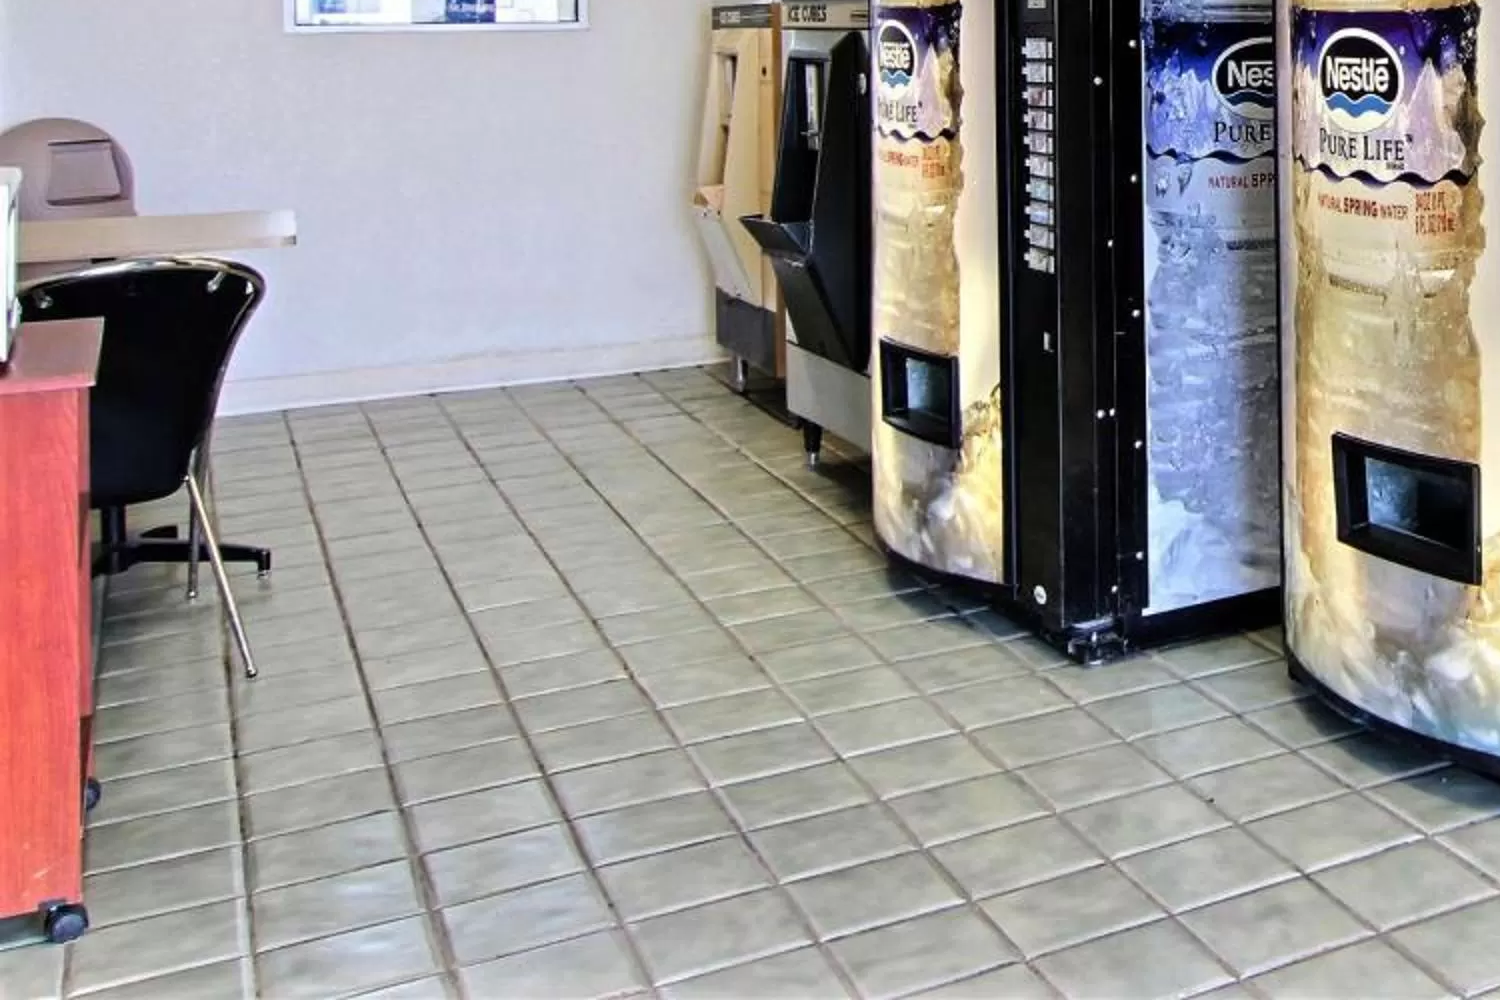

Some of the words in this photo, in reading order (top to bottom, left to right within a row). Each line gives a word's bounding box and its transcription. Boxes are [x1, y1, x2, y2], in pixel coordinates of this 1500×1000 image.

[1213, 121, 1273, 144] PURE
[1319, 127, 1358, 161] PURE
[1363, 135, 1405, 161] LIFE
[1207, 174, 1249, 189] NATURAL
